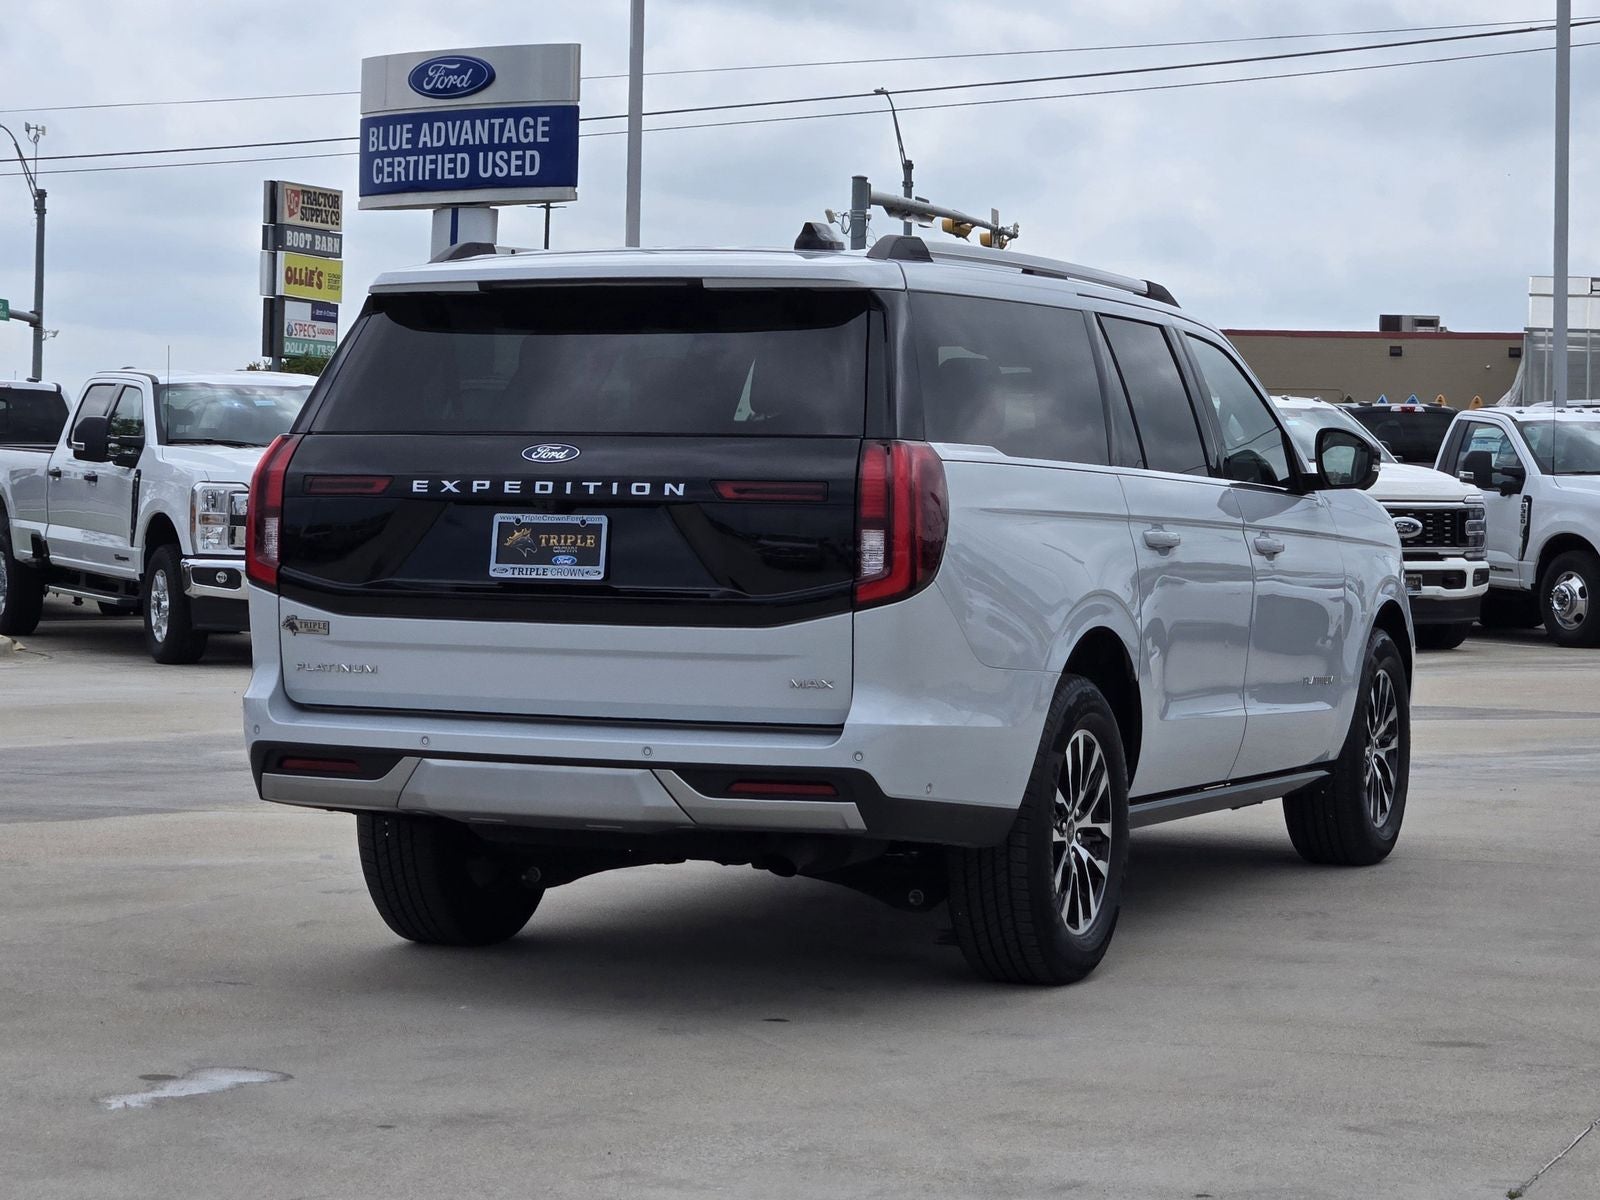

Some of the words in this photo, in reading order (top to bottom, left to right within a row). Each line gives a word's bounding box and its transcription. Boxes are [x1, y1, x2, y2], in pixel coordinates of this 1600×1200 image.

[423, 63, 473, 90] Ford
[369, 123, 413, 152] BLUE
[418, 116, 550, 148] ADVANTAGE
[372, 152, 470, 184] CERTIFIED
[478, 150, 541, 178] USED
[301, 189, 340, 209] TRACTOR
[300, 207, 330, 224] SUPPLY
[286, 230, 312, 249] BOOT
[314, 234, 340, 253] BARN
[285, 341, 314, 355] DOLLAR
[531, 445, 567, 459] Ford
[412, 479, 685, 496] EXPEDITION
[539, 534, 596, 548] TRIPLE
[510, 567, 549, 576] TRIPLE
[550, 567, 585, 577] CROWN
[299, 621, 327, 630] TRIPLE
[296, 663, 378, 674] PLATINUM
[790, 679, 834, 689] MAX
